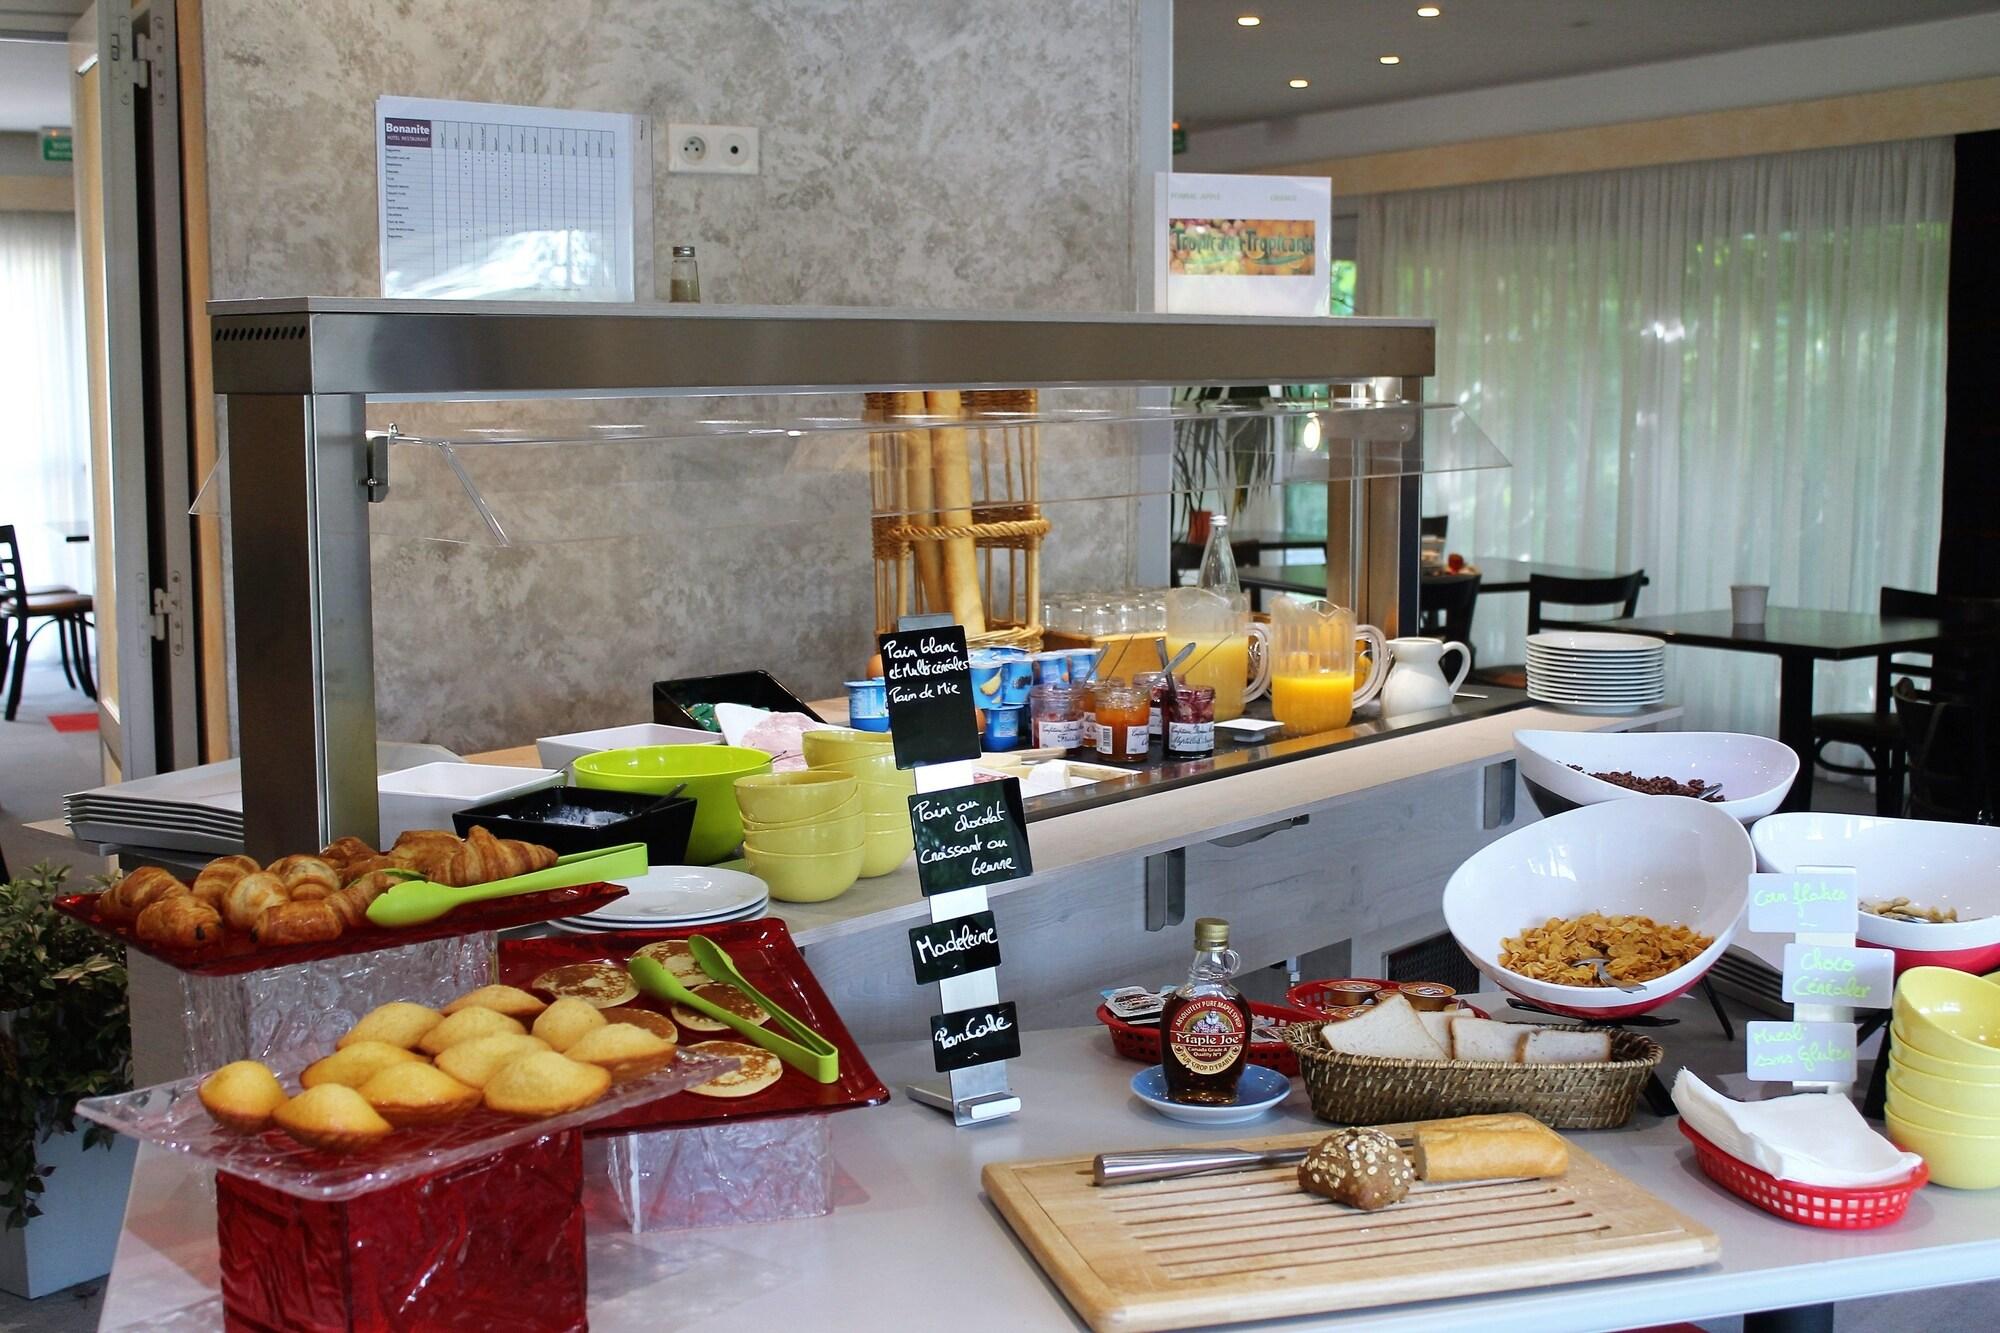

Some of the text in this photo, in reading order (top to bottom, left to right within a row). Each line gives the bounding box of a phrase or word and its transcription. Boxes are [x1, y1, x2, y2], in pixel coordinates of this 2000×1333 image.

[386, 122, 430, 135] Bonanite
[883, 636, 958, 659] Pain blanc
[889, 663, 903, 679] et
[919, 684, 935, 698] de
[937, 682, 960, 695] Mie
[913, 800, 979, 822] Pain au
[920, 834, 1008, 864] Croissant au
[916, 924, 998, 964] Madeleine
[1176, 1002, 1201, 1027] ABSOLUTELY
[1202, 1000, 1218, 1008] PURE
[1217, 1001, 1234, 1014] MAPLE
[1231, 1011, 1242, 1028] SYRUP
[1176, 1032, 1217, 1046] Maple
[1191, 1061, 1208, 1071] SIROP
